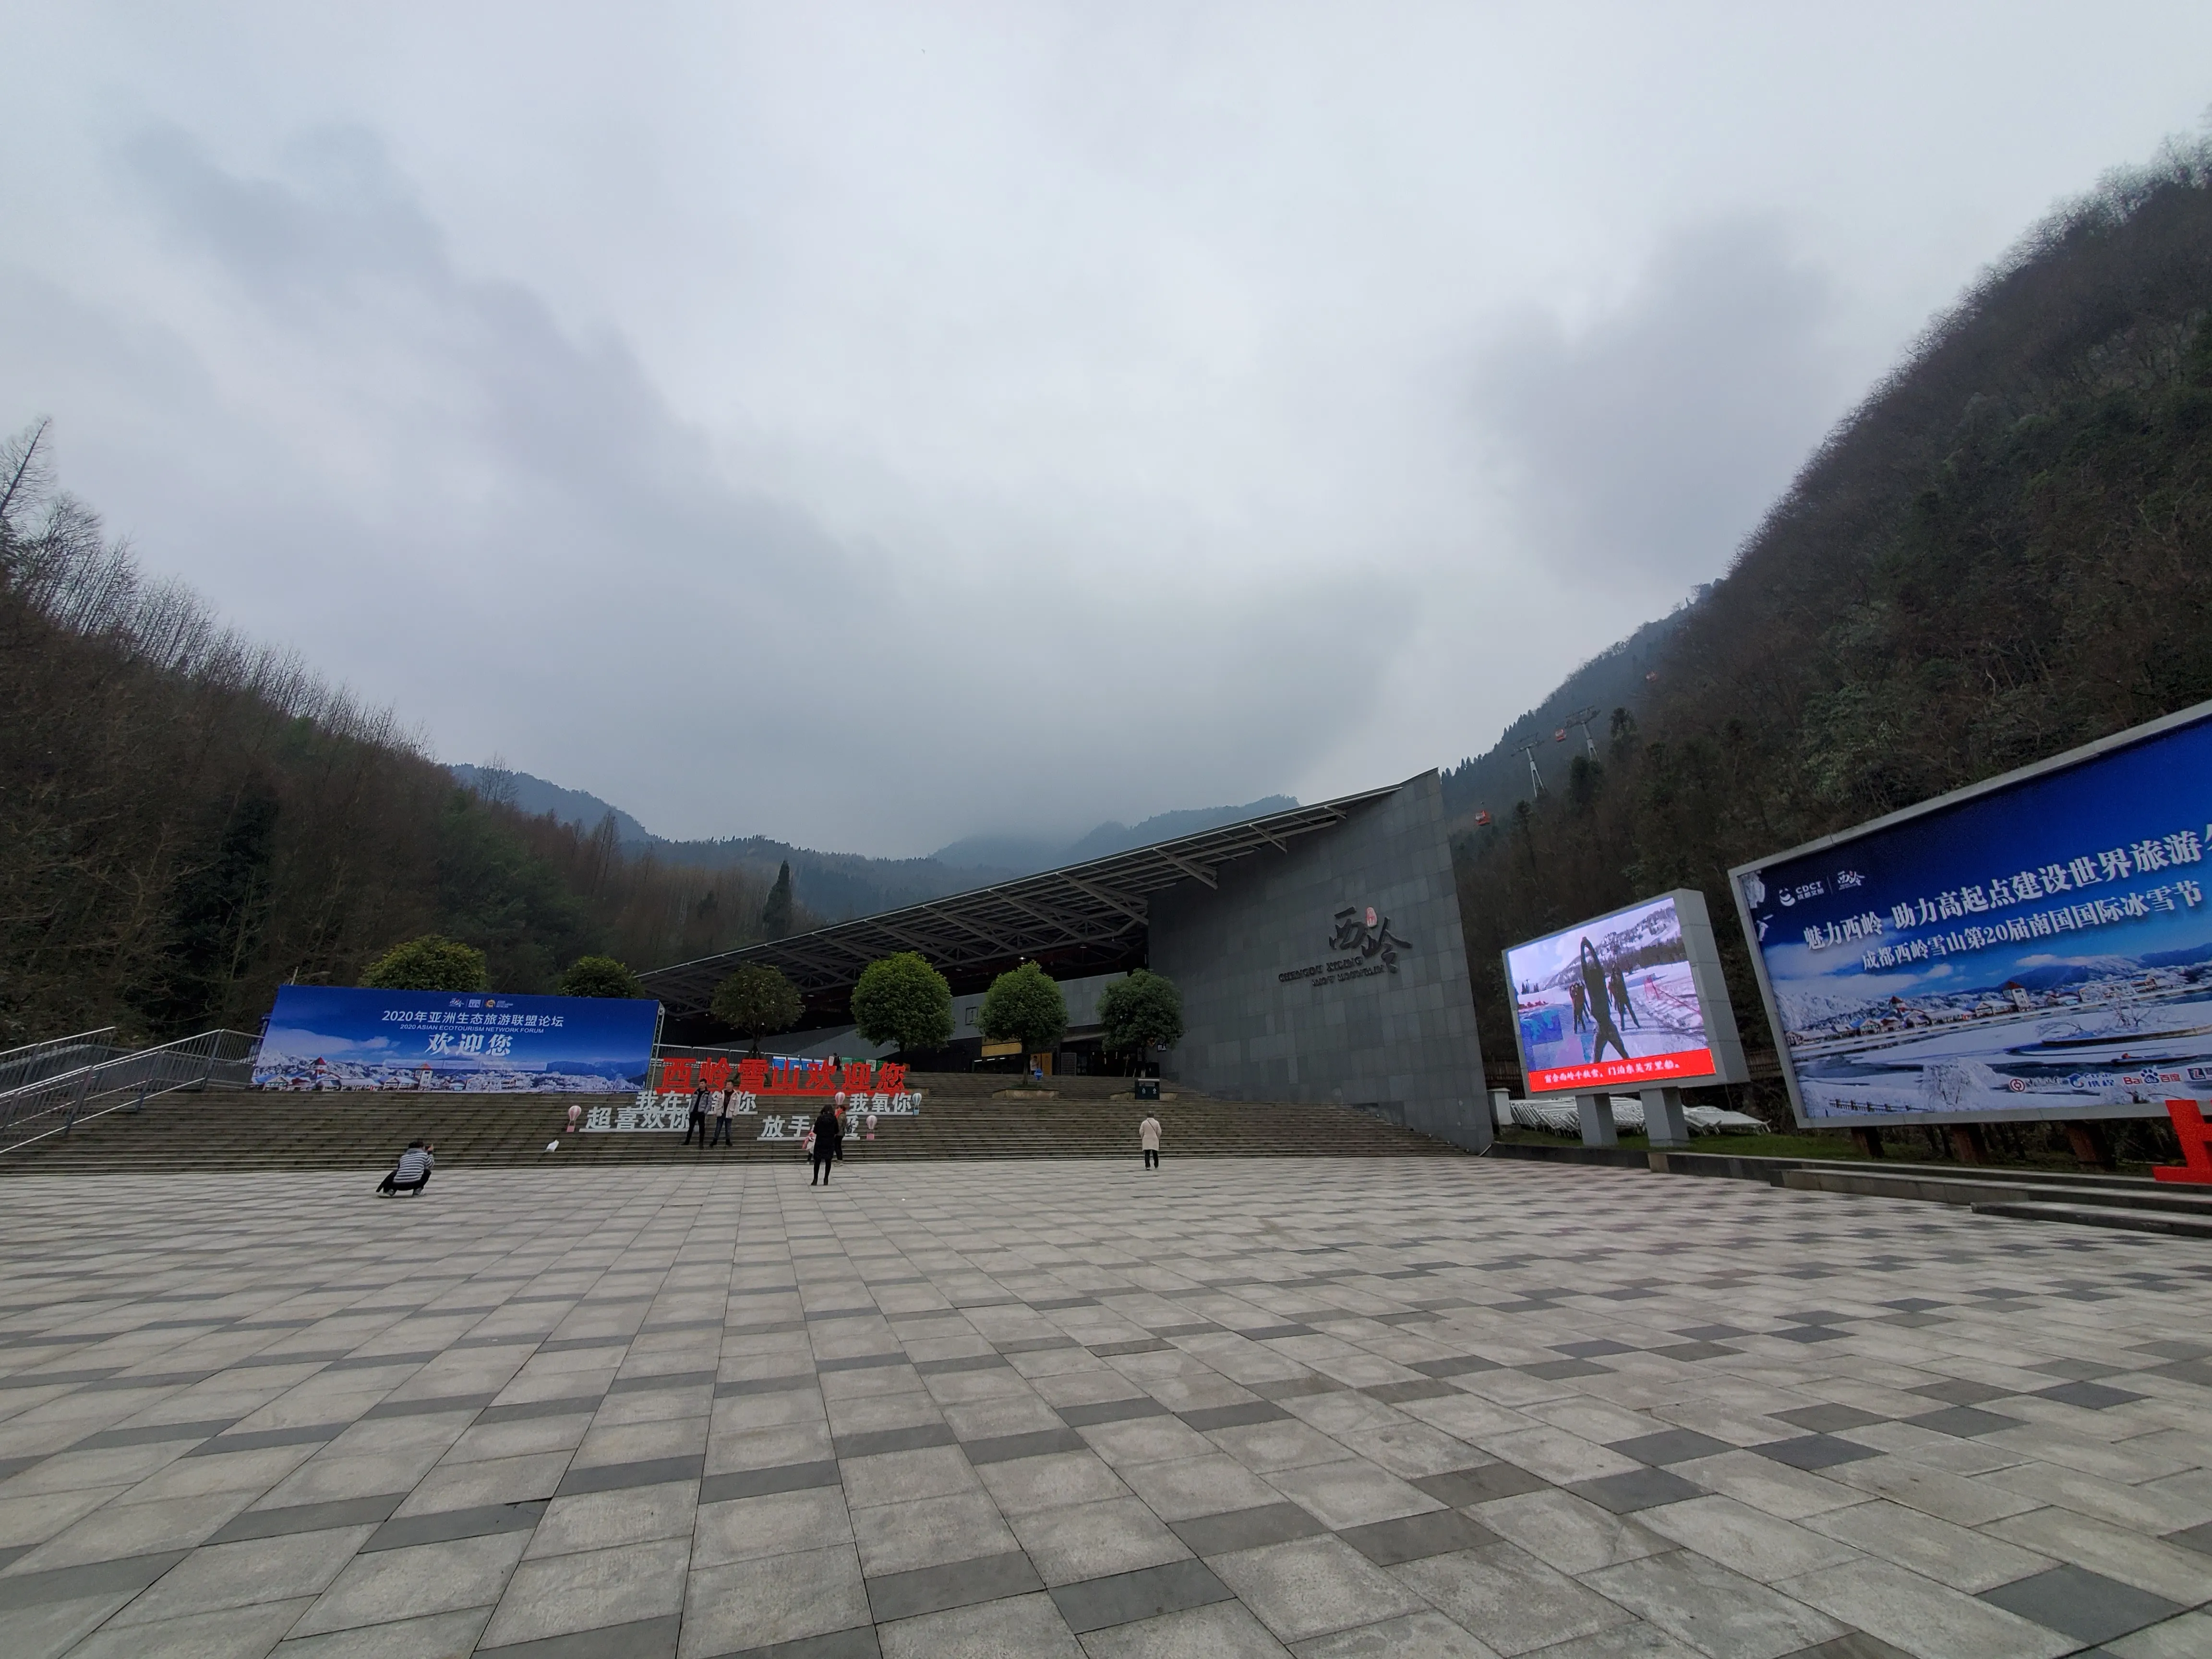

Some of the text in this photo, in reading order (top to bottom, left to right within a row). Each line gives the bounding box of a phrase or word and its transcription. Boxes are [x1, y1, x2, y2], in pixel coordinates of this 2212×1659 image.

[1795, 881, 1822, 894] CDCT
[1803, 911, 1883, 950] 魅力西岭
[1862, 880, 2202, 971] 成都西岭雪山第20届南国国际冰雪节
[1278, 956, 1363, 982] CHENGDU XILING
[1337, 964, 1384, 982] MOUNTAIN
[382, 1010, 564, 1027] 2020年亚洲生态旅游联盟论坛
[424, 1032, 513, 1056] 欢迎您
[662, 1057, 906, 1091] 西岭雪山欢迎您
[849, 1092, 912, 1113] 我氧你
[585, 1106, 690, 1129] 超喜欢你
